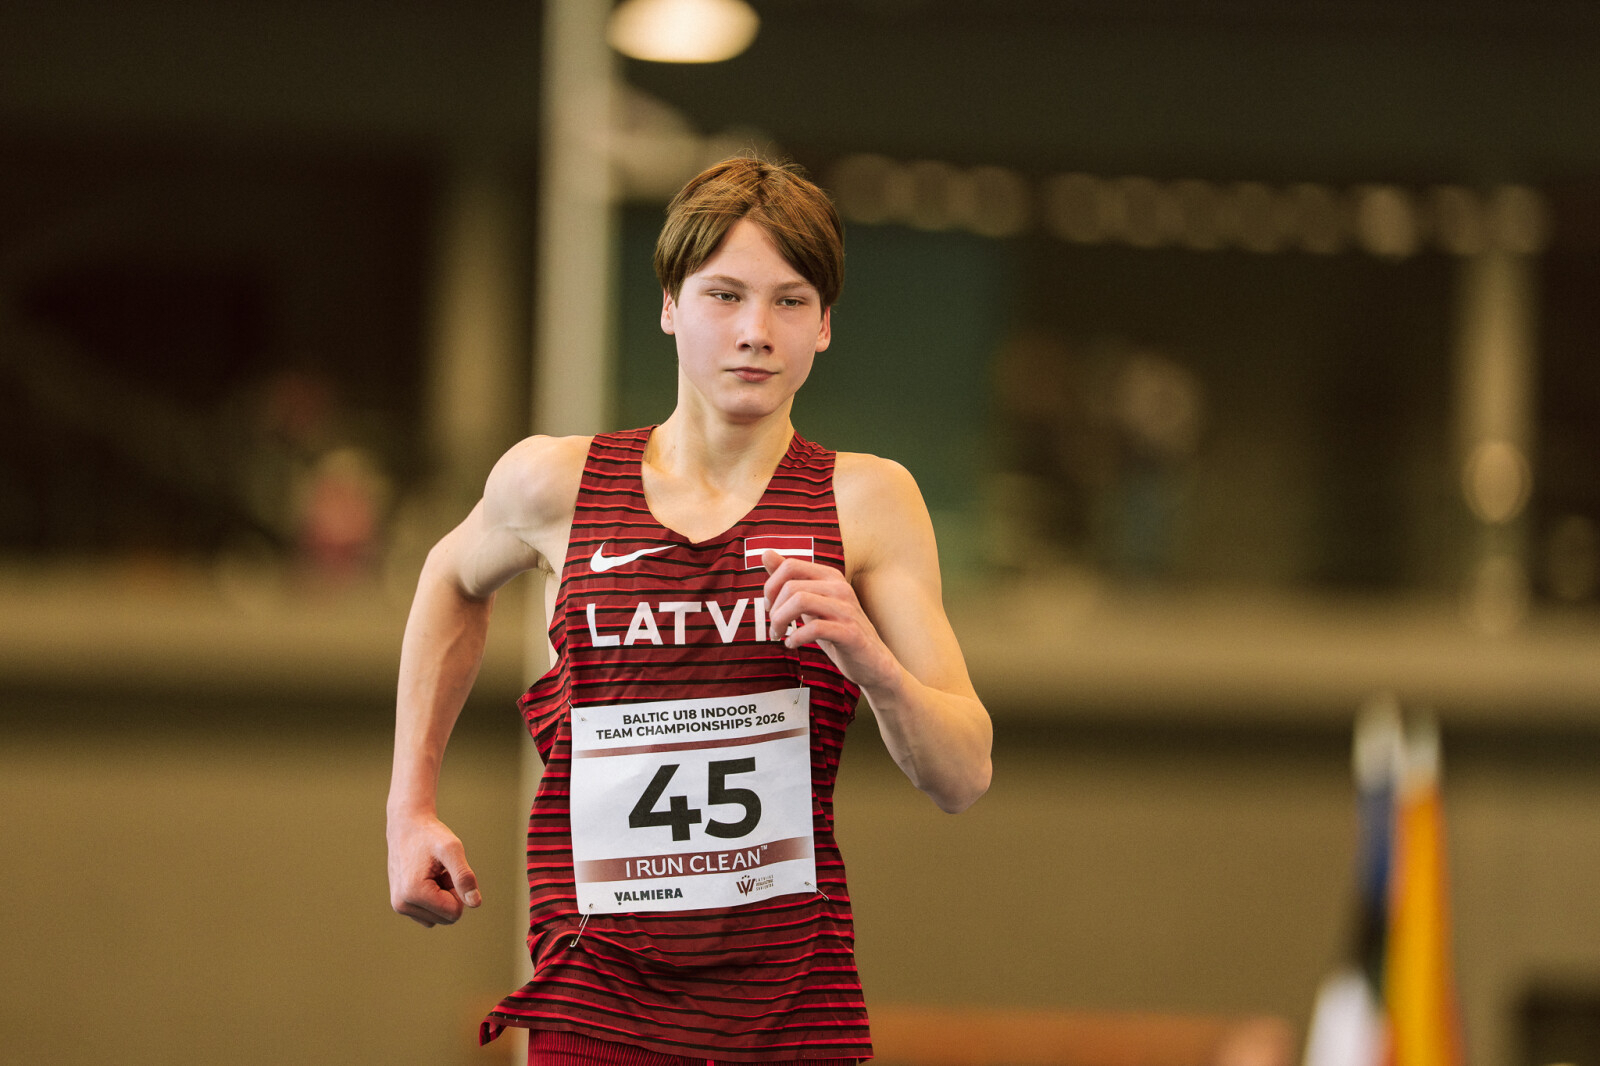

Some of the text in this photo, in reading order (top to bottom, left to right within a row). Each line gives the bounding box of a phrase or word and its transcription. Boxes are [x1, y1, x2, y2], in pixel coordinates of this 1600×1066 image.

[586, 597, 797, 647] LATVI
[596, 712, 785, 740] TEAM CHAMPIONSHIPS 2026
[623, 704, 757, 725] BALTIC U18 INDOOR
[628, 756, 762, 842] 45
[625, 860, 631, 878] I
[636, 856, 684, 877] RUN
[614, 888, 683, 903] VALMIERA
